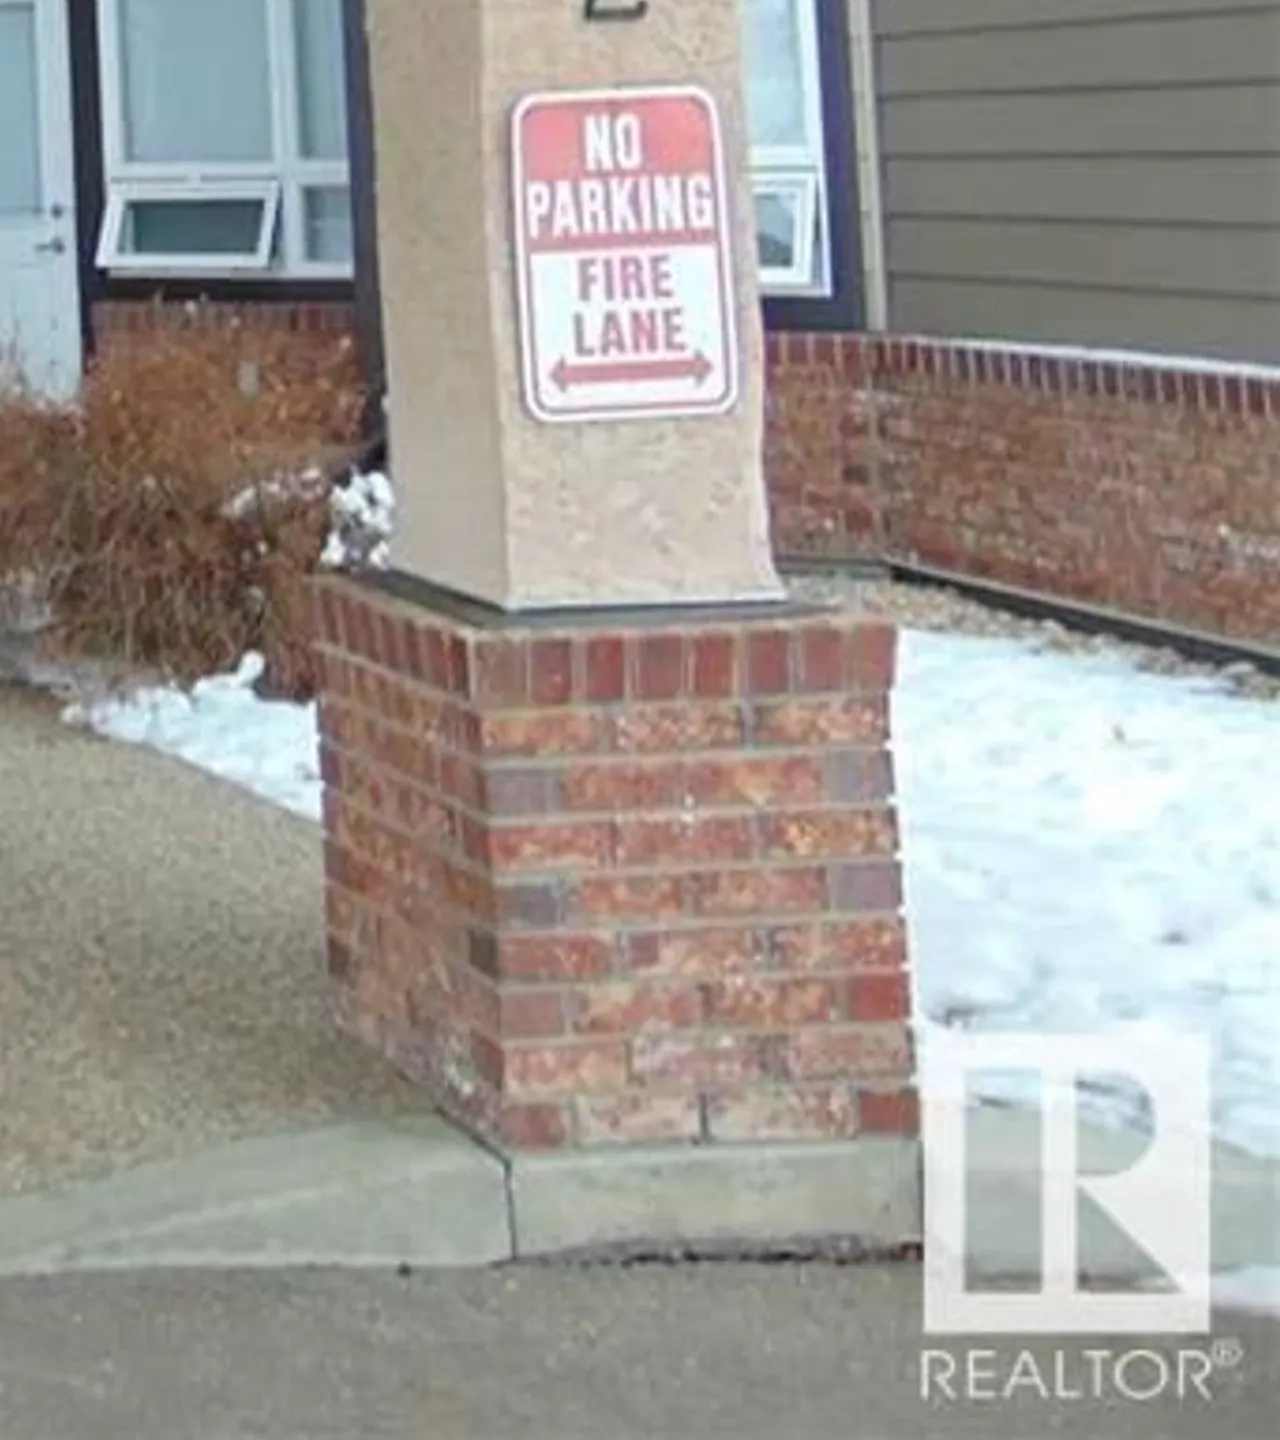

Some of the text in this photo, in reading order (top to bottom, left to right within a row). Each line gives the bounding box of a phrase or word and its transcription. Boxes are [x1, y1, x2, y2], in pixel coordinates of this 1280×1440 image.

[583, 112, 643, 172] NO
[526, 173, 715, 240] PARKING
[576, 254, 675, 302] FIRE
[572, 308, 689, 358] LANE
